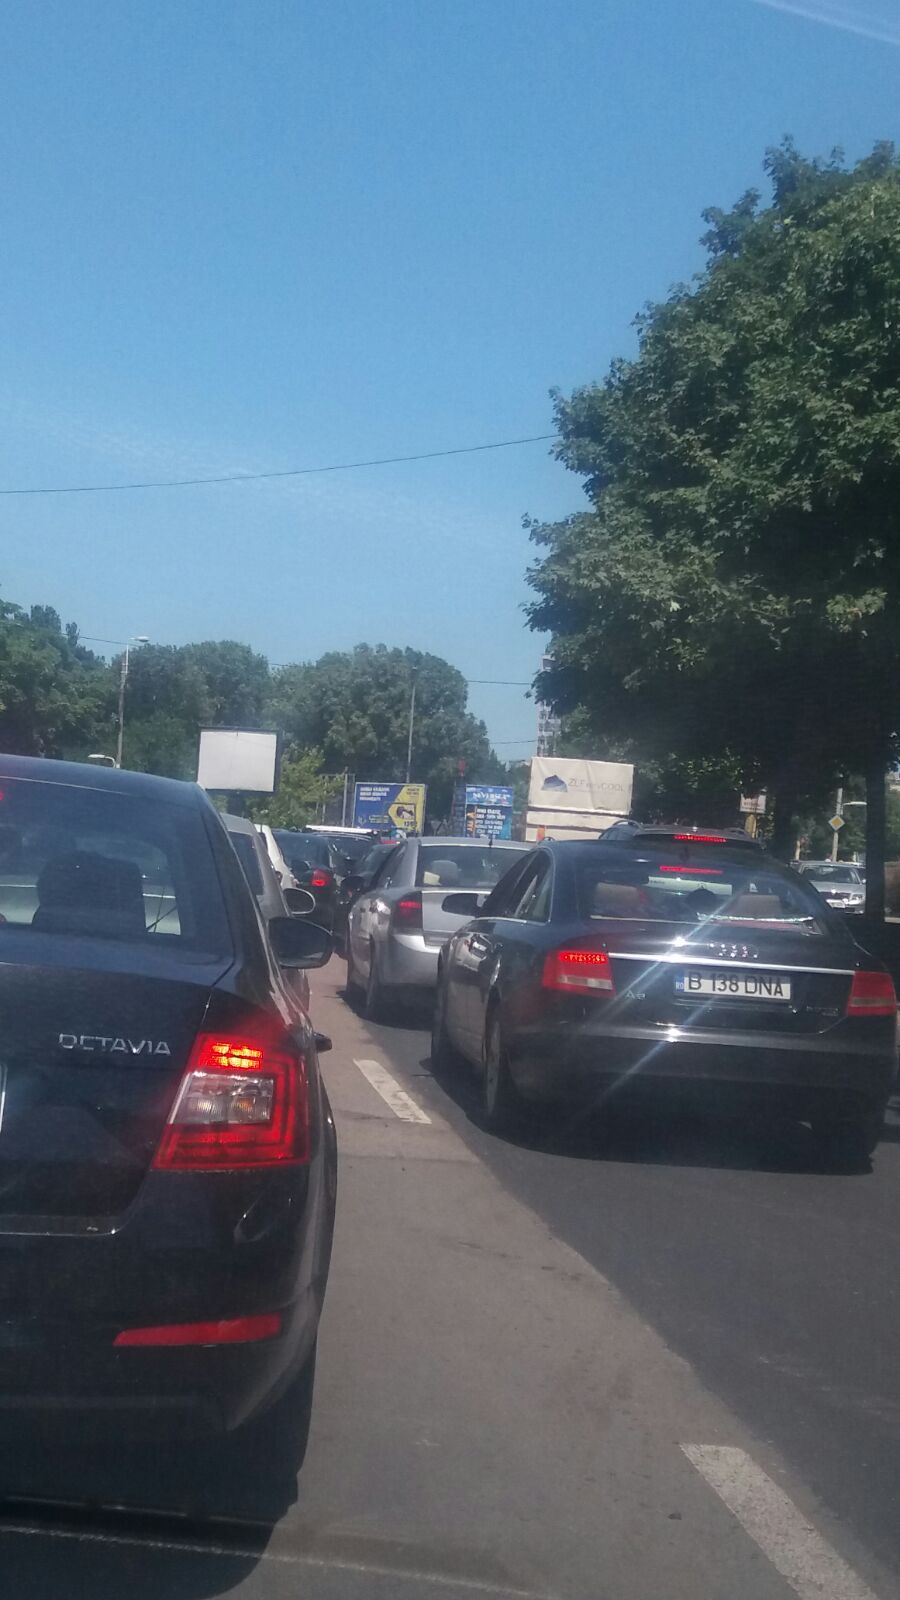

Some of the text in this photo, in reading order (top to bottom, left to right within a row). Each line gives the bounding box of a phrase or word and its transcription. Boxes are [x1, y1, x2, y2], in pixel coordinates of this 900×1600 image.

[688, 971, 784, 997] B 138 DNA
[58, 1033, 171, 1055] OCTAVIA
